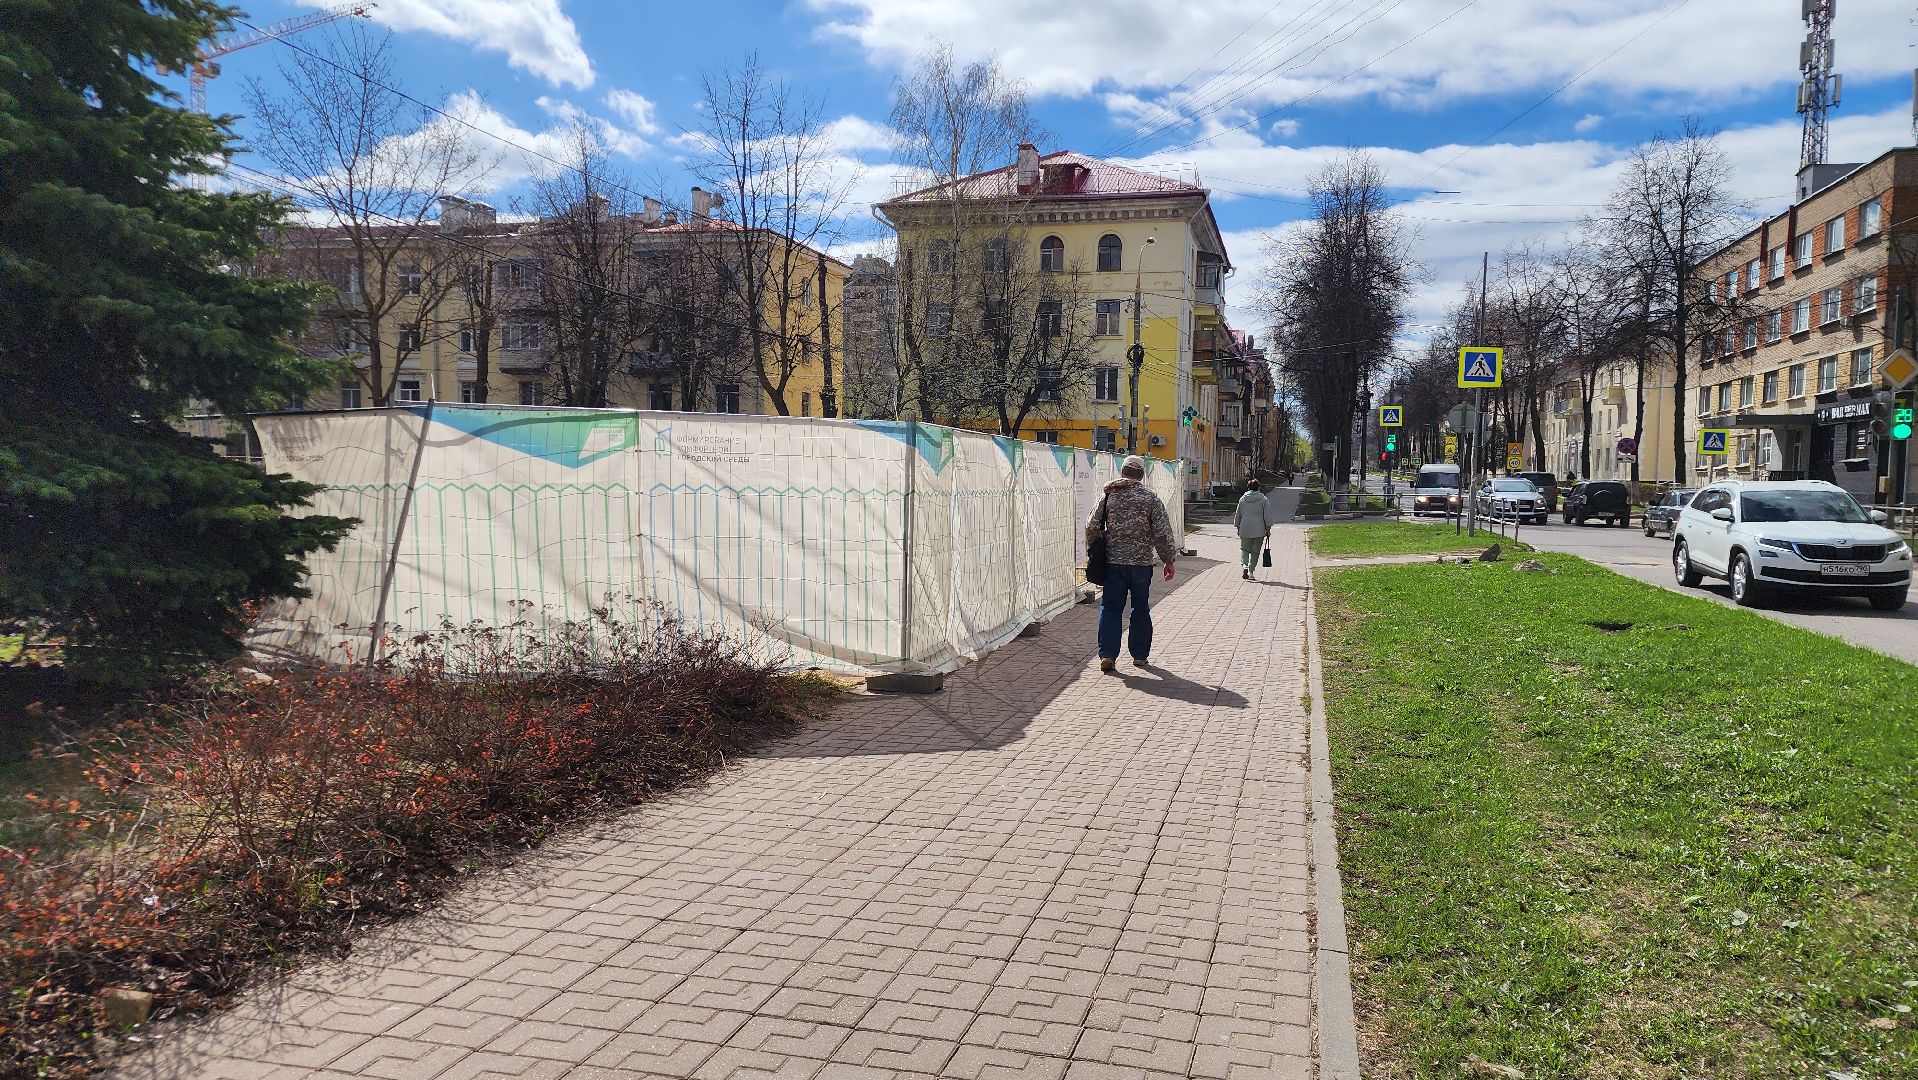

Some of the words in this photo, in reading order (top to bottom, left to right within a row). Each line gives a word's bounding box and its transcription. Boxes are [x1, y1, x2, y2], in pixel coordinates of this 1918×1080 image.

[1895, 408, 1912, 422] 28
[676, 436, 741, 444] ФОРМИРОВАНИЕ
[676, 444, 729, 453] КОМФОРТНОЙ
[676, 454, 722, 462] ГОРОДСКОЙ
